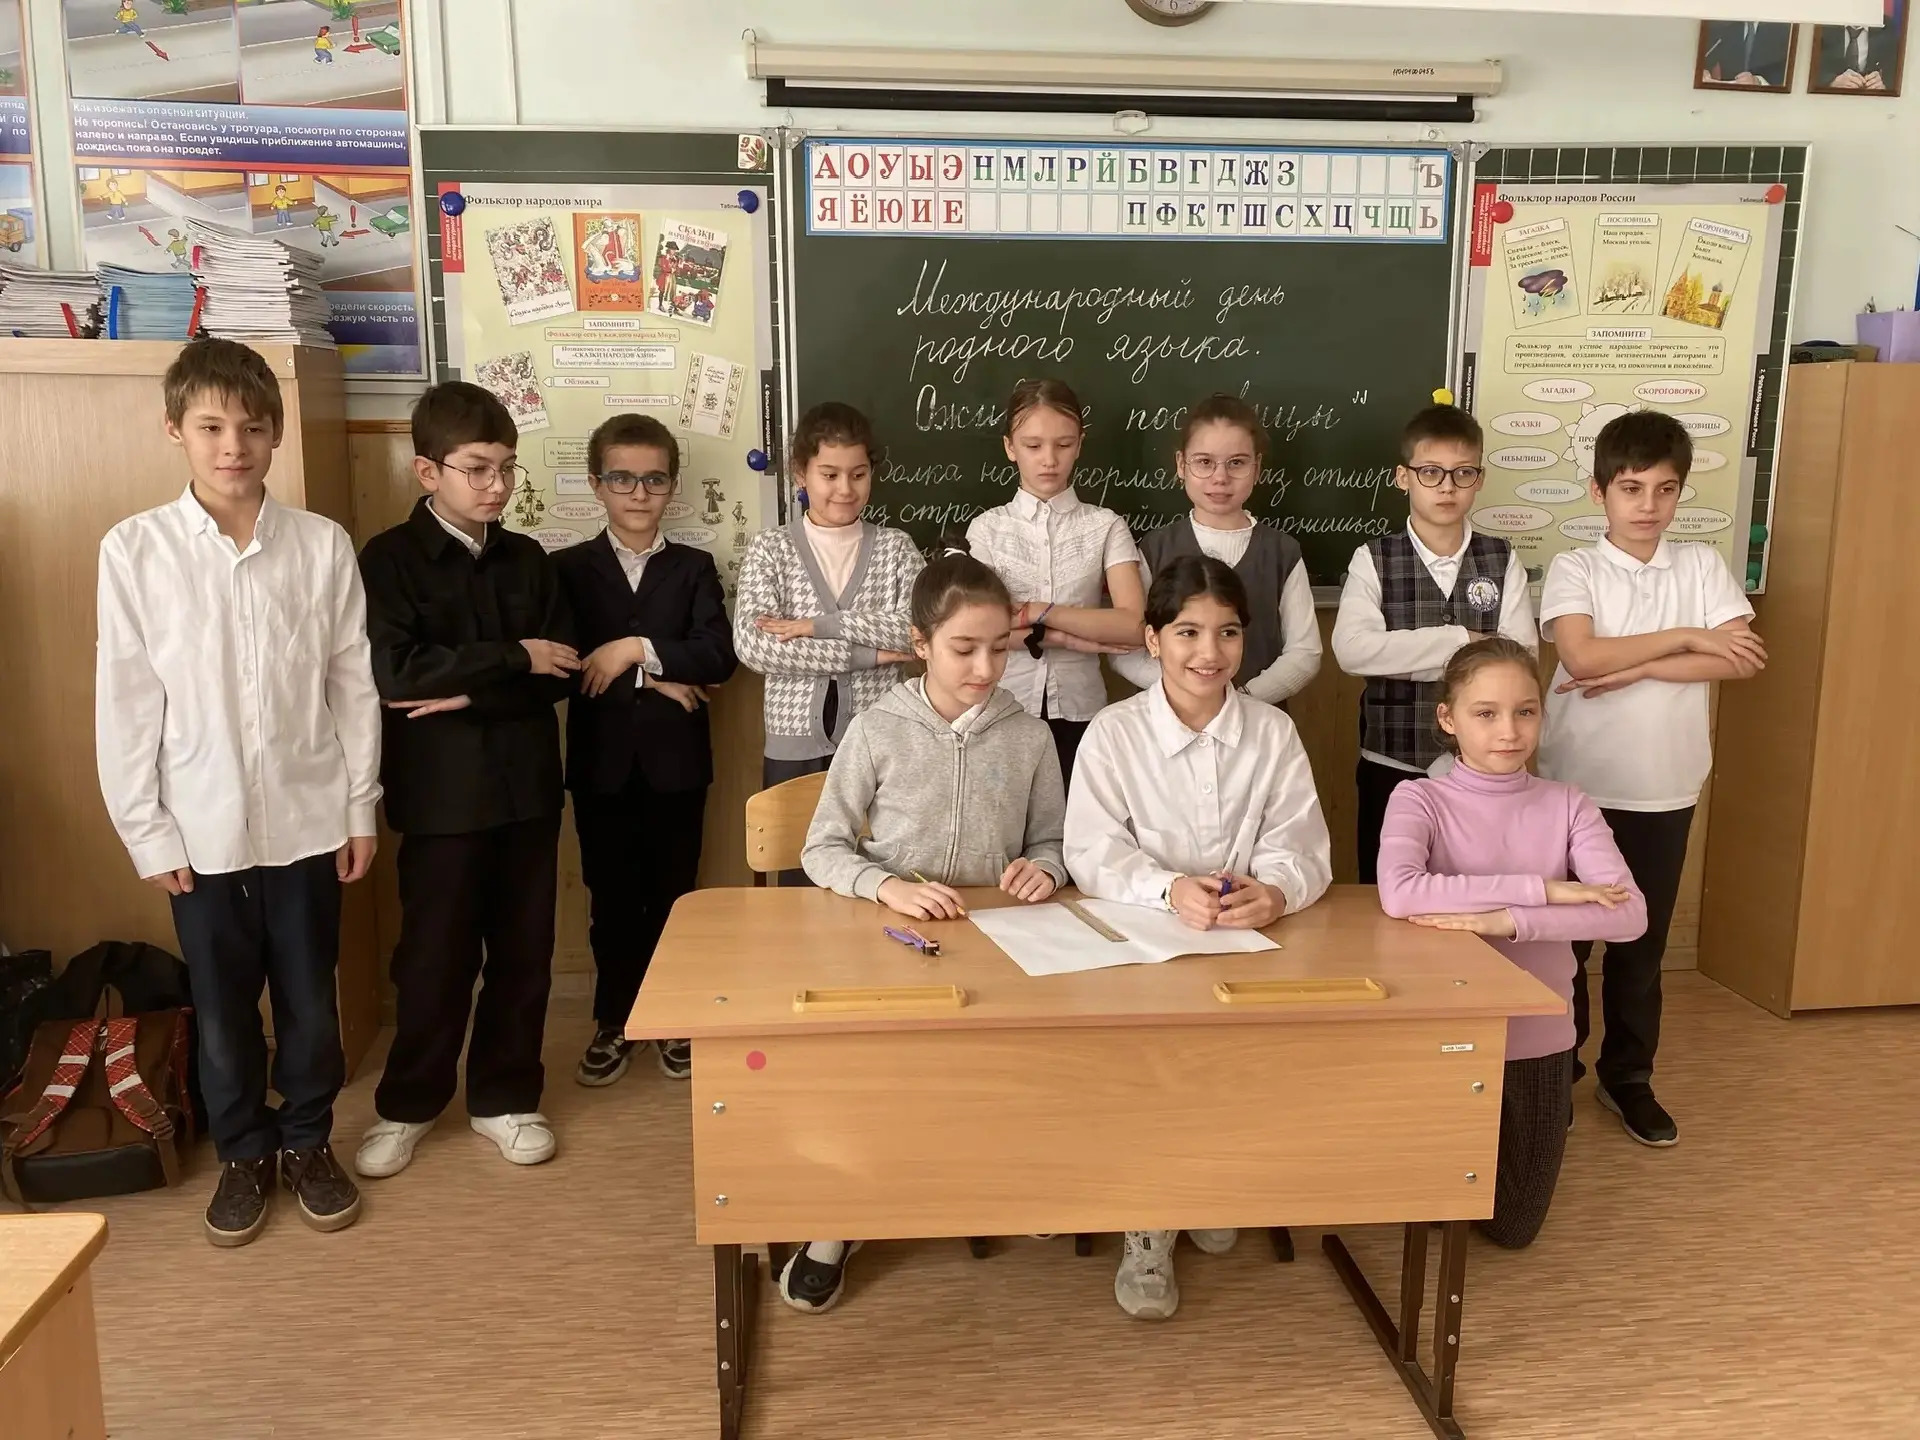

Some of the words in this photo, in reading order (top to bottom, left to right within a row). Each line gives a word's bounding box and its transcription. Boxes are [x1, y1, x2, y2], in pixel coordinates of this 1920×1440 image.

[12, 115, 26, 124] по
[12, 128, 27, 136] по
[74, 117, 88, 127] Не
[91, 118, 147, 129] торопись!
[150, 120, 217, 132] Остановись
[220, 124, 227, 133] у
[230, 124, 282, 135] тротуара,
[285, 126, 336, 137] посмотри
[339, 128, 352, 136] по
[355, 128, 406, 138] сторонам
[75, 131, 115, 140] налево
[117, 132, 125, 140] и
[127, 133, 178, 143] направо.
[179, 134, 208, 144] Если
[209, 136, 259, 147] увидишь
[261, 137, 333, 147] приближение
[335, 140, 406, 150] автомашины,
[740, 137, 750, 148] 9
[76, 142, 125, 153] дождись
[126, 144, 151, 154] пока
[175, 146, 222, 157] проедет.
[464, 194, 522, 208] Фольклор
[526, 198, 571, 208] народов
[574, 199, 602, 208] мира
[1499, 193, 1552, 205] Фольклор
[1555, 195, 1597, 205] народов
[1600, 193, 1636, 202] России
[678, 224, 715, 241] СКАЗКИ
[1519, 224, 1550, 236] ЗАГАДКА
[1694, 221, 1745, 241] СКОРОГОВОРКА
[897, 259, 1195, 334] Международный
[1218, 283, 1285, 324] день
[367, 304, 414, 313] скорость
[909, 334, 1075, 383] родного
[1106, 334, 1260, 383] языка.
[564, 378, 599, 386] Обложка
[607, 396, 649, 404] Титульный
[1501, 455, 1546, 463] НЕБЫЛИЦЫ
[1254, 468, 1292, 507] аз
[1303, 466, 1400, 511] отмер
[899, 502, 986, 538] отре
